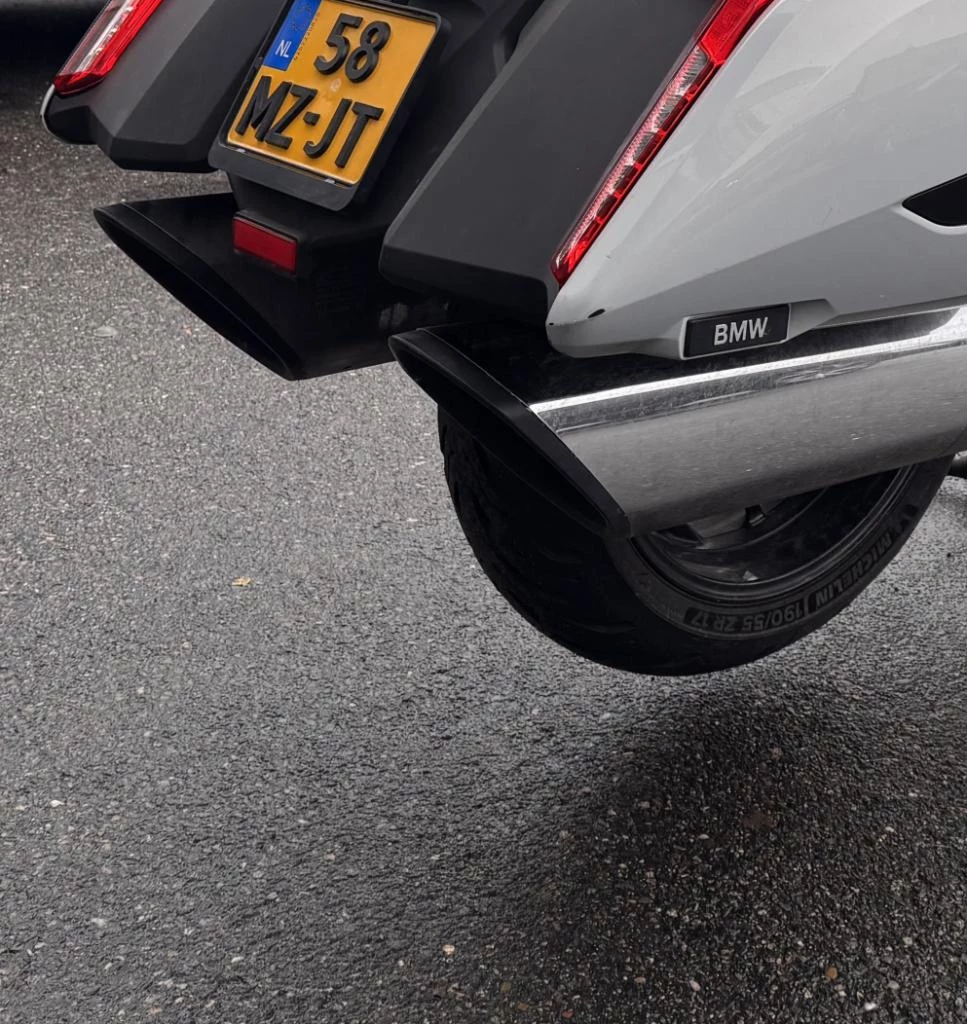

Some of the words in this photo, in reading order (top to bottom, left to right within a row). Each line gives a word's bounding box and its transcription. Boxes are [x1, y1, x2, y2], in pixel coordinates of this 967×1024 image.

[275, 39, 291, 59] NL
[313, 12, 392, 84] 58
[235, 75, 384, 169] MZ-JT
[714, 316, 769, 346] BMW
[814, 531, 893, 610] MICHELIN
[690, 611, 709, 629] 17
[713, 614, 738, 633] ZR
[741, 601, 802, 632] 190/55
